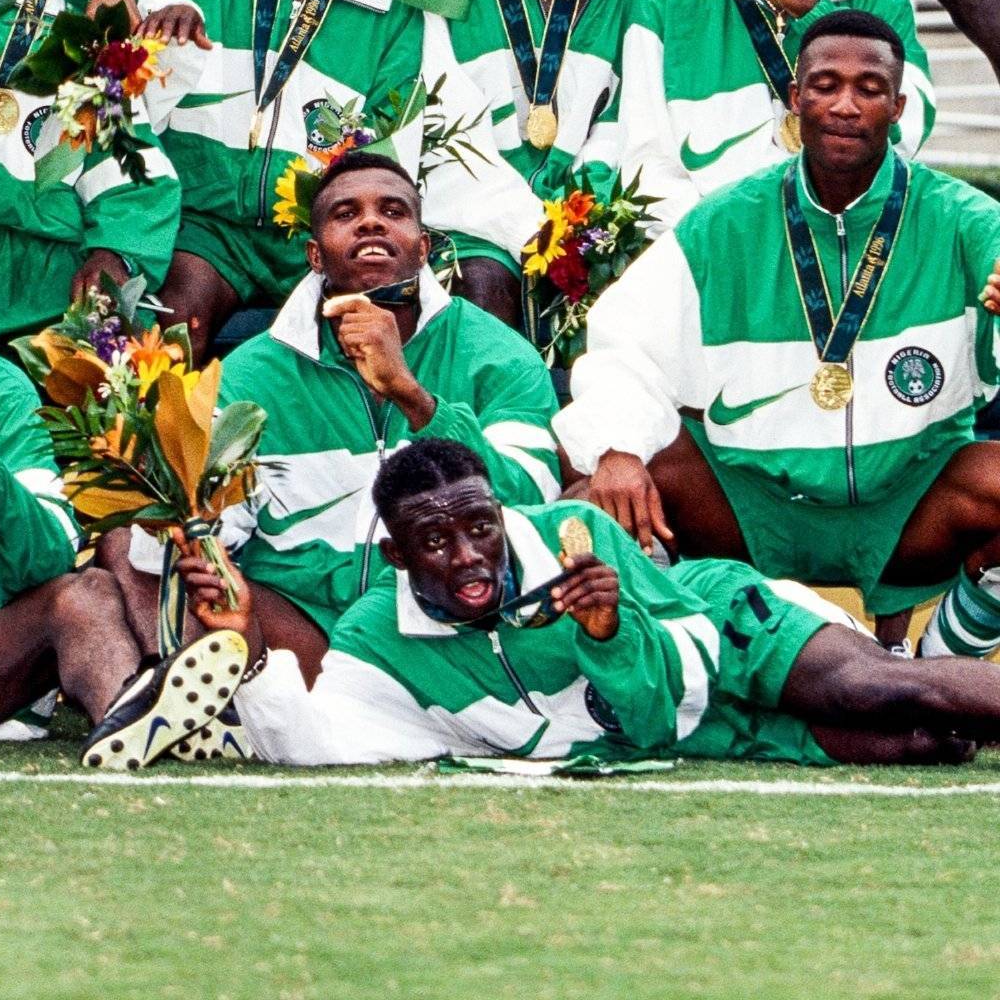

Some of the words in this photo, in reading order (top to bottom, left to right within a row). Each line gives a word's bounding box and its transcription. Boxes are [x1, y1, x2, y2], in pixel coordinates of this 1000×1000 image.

[852, 264, 876, 299] Atlanta
[868, 236, 885, 256] 1996
[891, 348, 931, 365] NIGERIA
